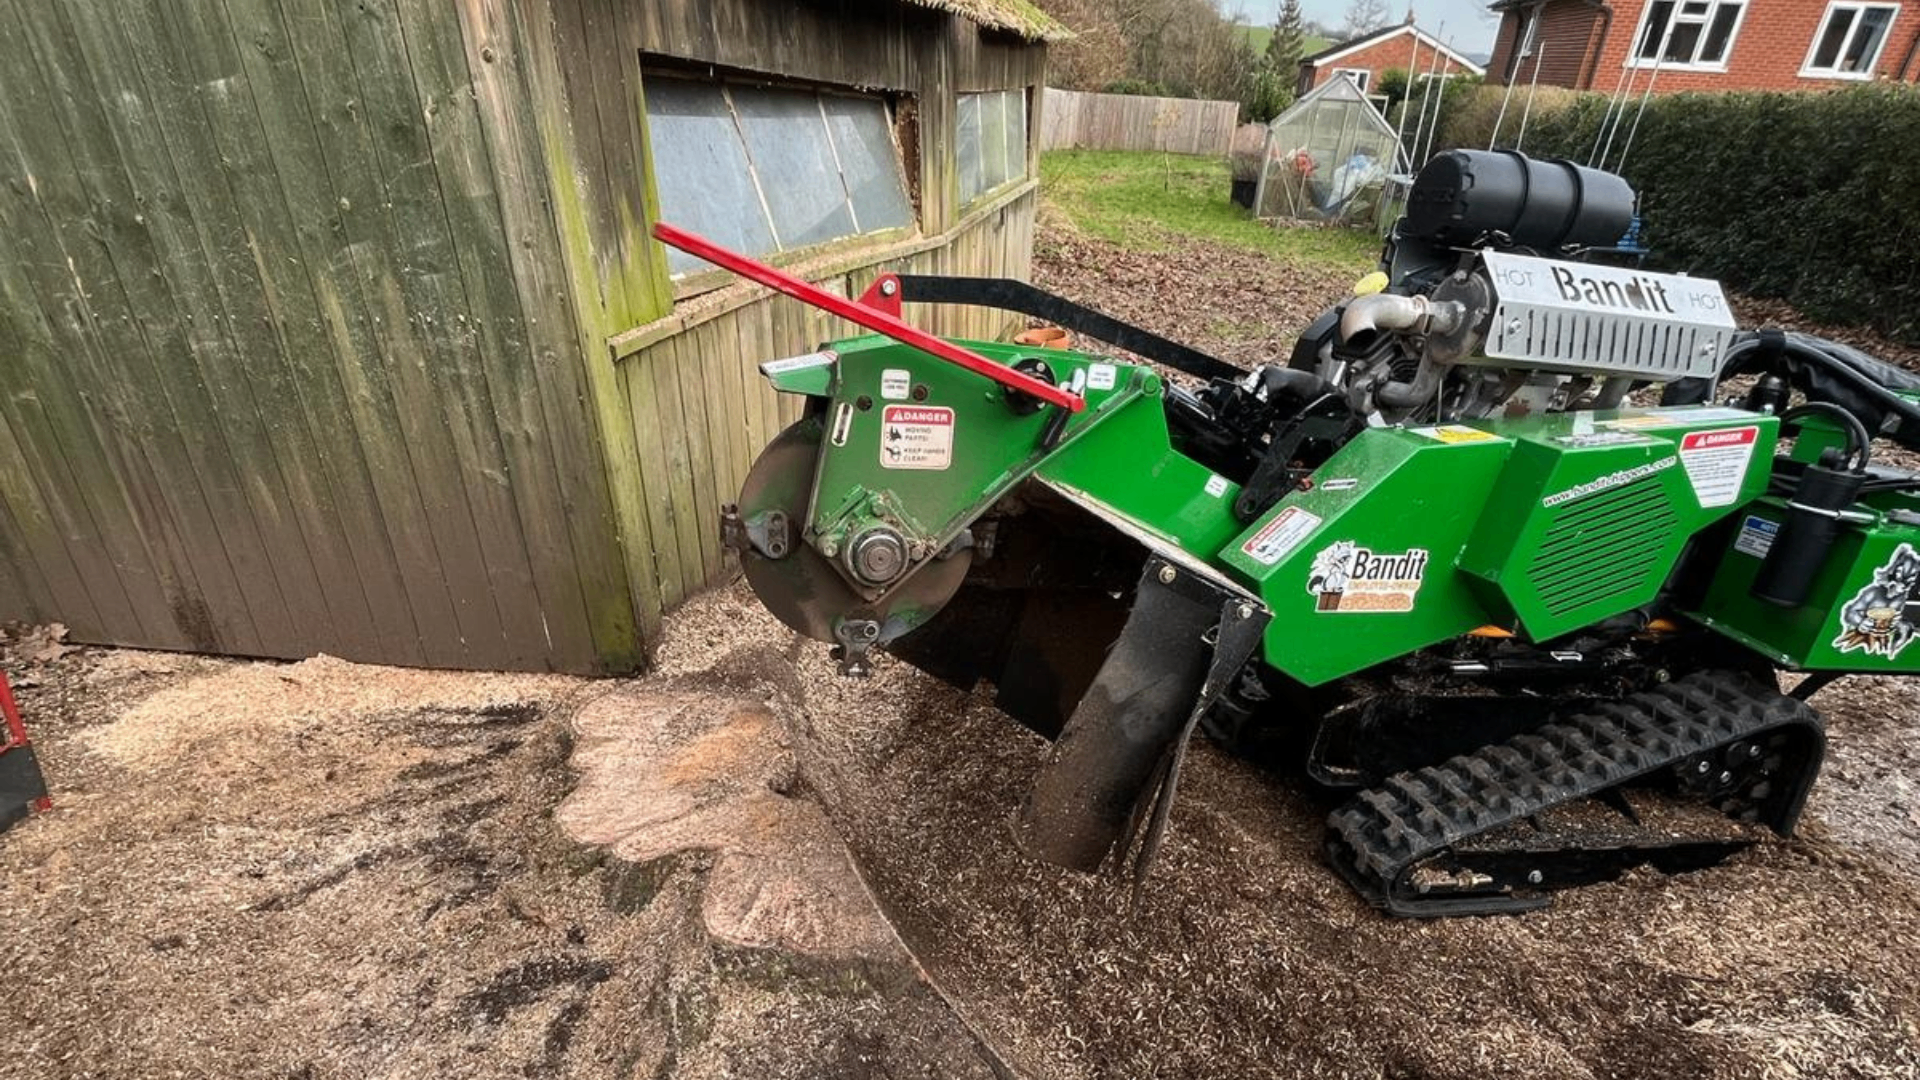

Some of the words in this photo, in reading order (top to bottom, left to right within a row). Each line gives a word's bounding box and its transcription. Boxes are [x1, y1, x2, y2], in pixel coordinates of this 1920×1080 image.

[1495, 269, 1535, 287] HOT
[1551, 266, 1675, 314] Bandit
[1688, 291, 1724, 311] HOT
[904, 411, 948, 422] DANGER
[1706, 431, 1743, 445] DANGER
[1351, 550, 1426, 580] Bandit
